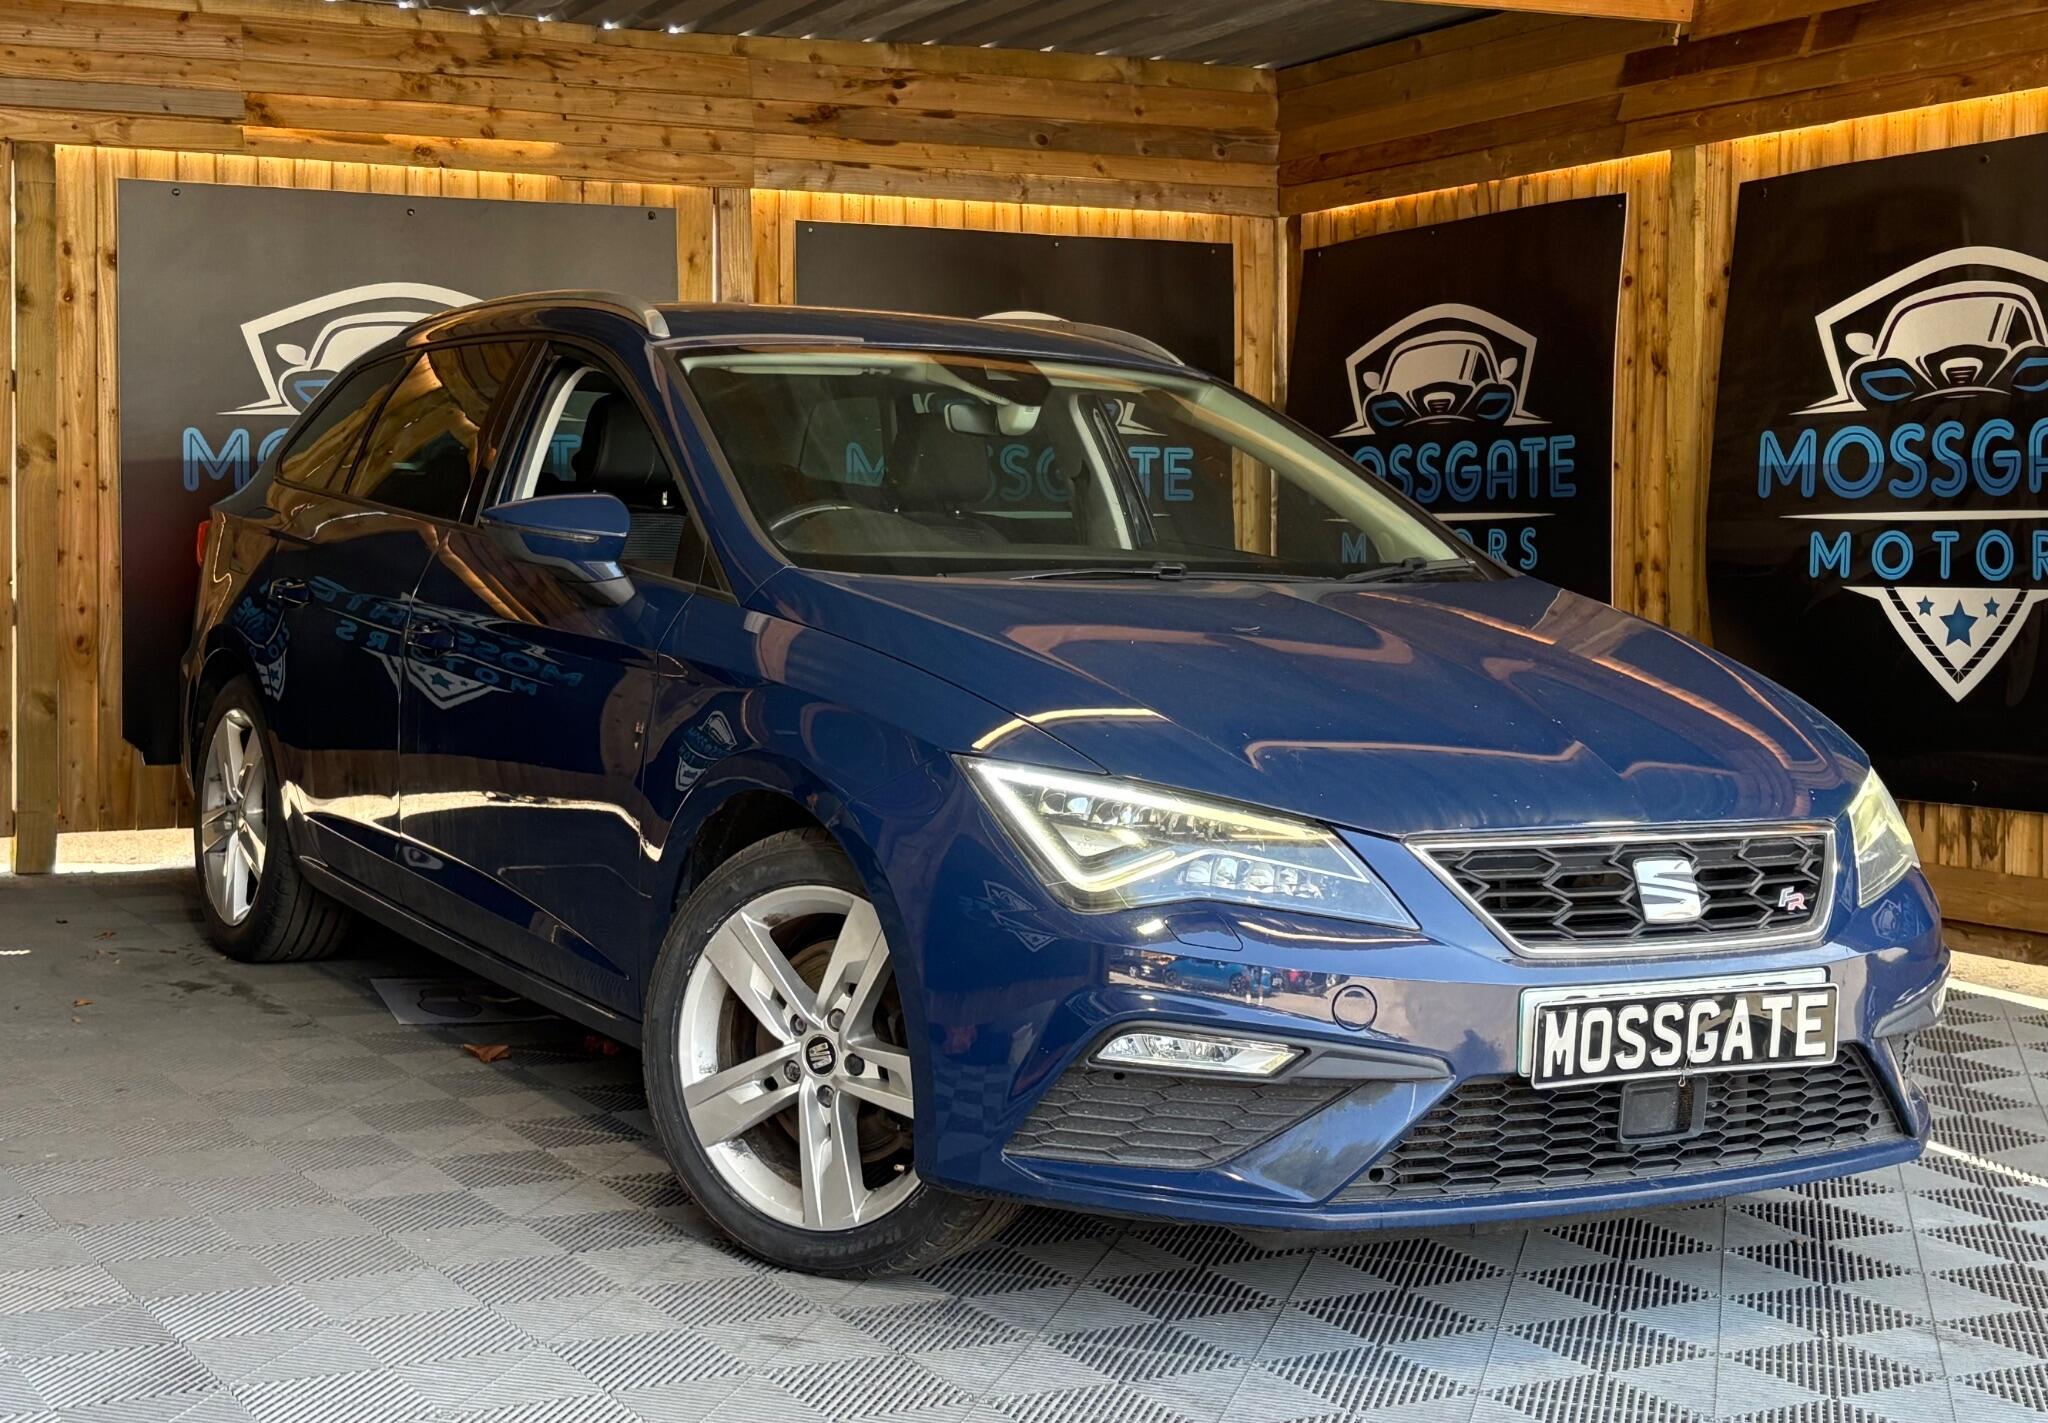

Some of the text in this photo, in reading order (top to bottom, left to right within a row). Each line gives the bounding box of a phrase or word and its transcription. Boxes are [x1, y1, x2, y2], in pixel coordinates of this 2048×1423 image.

[1352, 434, 1577, 503] SSGATE
[1777, 885, 1807, 911] FR
[1542, 991, 1829, 1078] MOSSGATE
